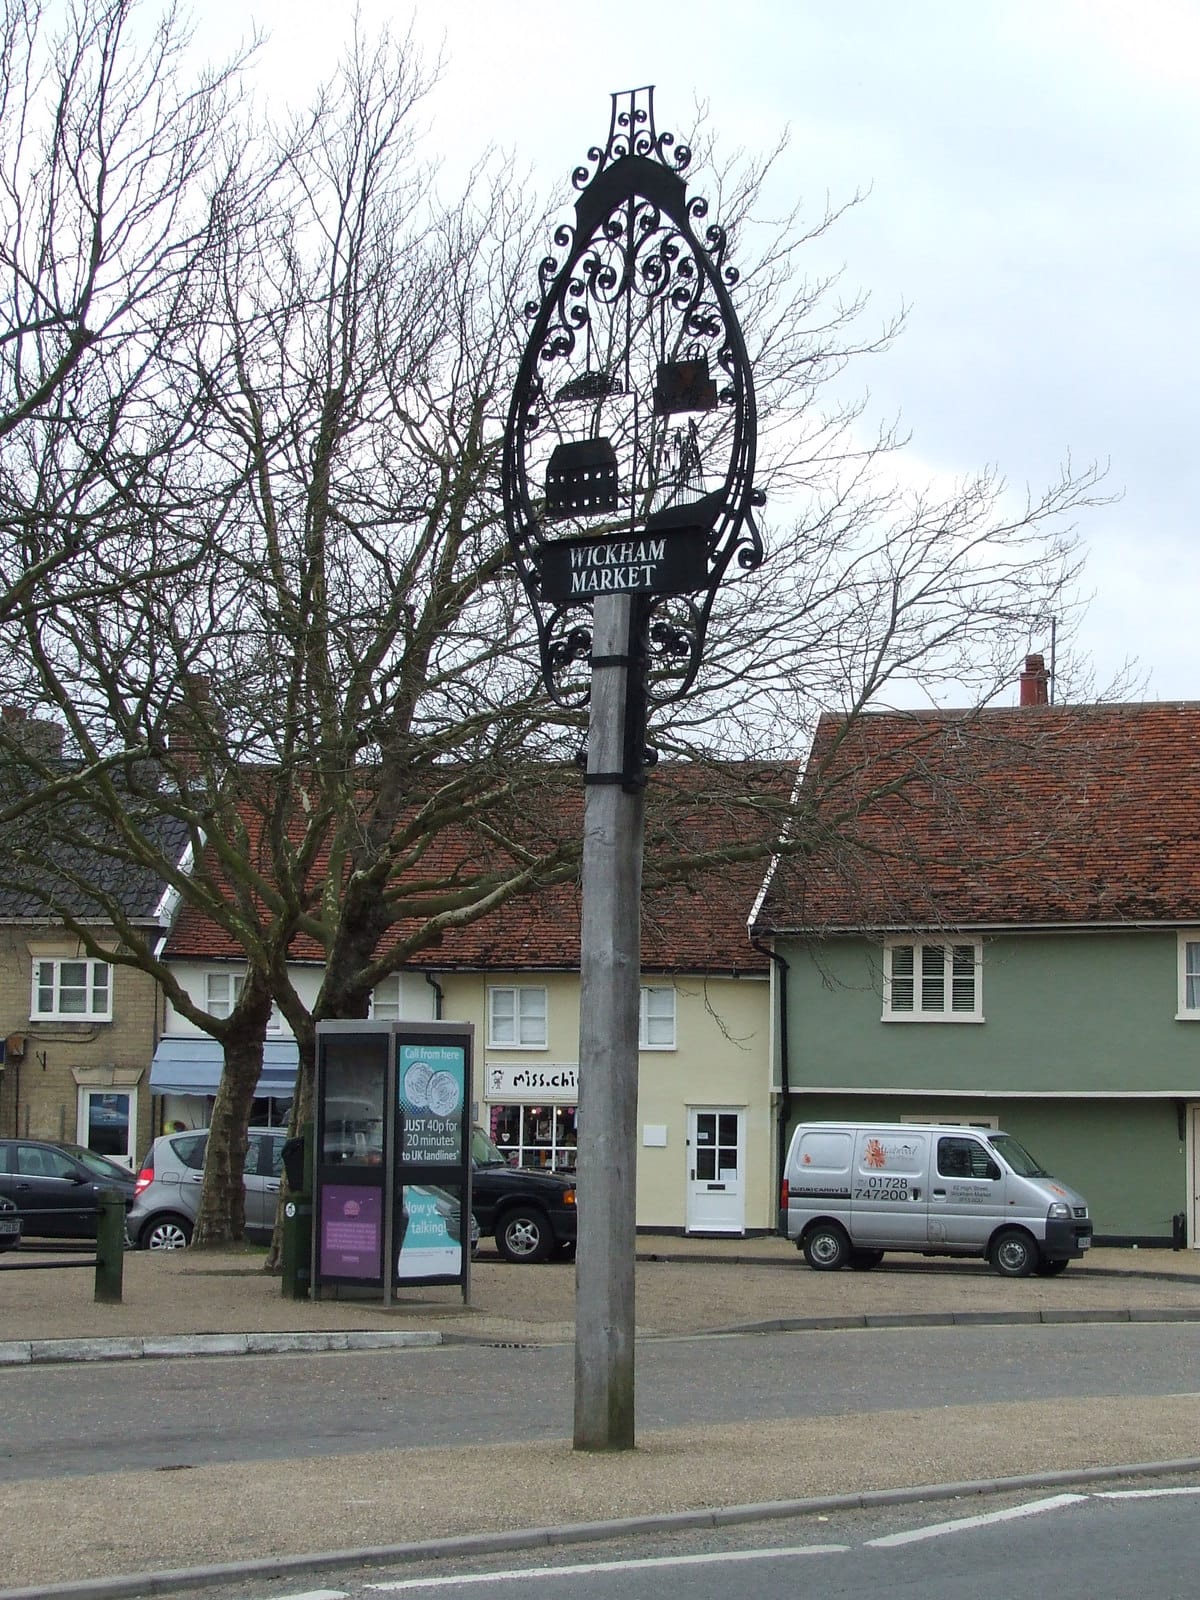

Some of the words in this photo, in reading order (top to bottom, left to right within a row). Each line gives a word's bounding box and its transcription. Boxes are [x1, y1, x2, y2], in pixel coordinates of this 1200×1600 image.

[569, 539, 667, 568] WICKHAM
[570, 564, 657, 593] MARKET
[405, 1047, 420, 1059] Call
[420, 1048, 441, 1060] from
[441, 1049, 460, 1060] here
[513, 1070, 580, 1087] miss.chi
[403, 1119, 426, 1132] JUST
[427, 1119, 445, 1134] 40p
[445, 1119, 458, 1132] for
[407, 1133, 419, 1146] 20
[420, 1134, 455, 1146] minutes
[402, 1151, 411, 1160] to
[411, 1150, 423, 1161] UK
[868, 1177, 908, 1189] 01728
[854, 1188, 908, 1201] 747200
[411, 1219, 447, 1237] talking!
